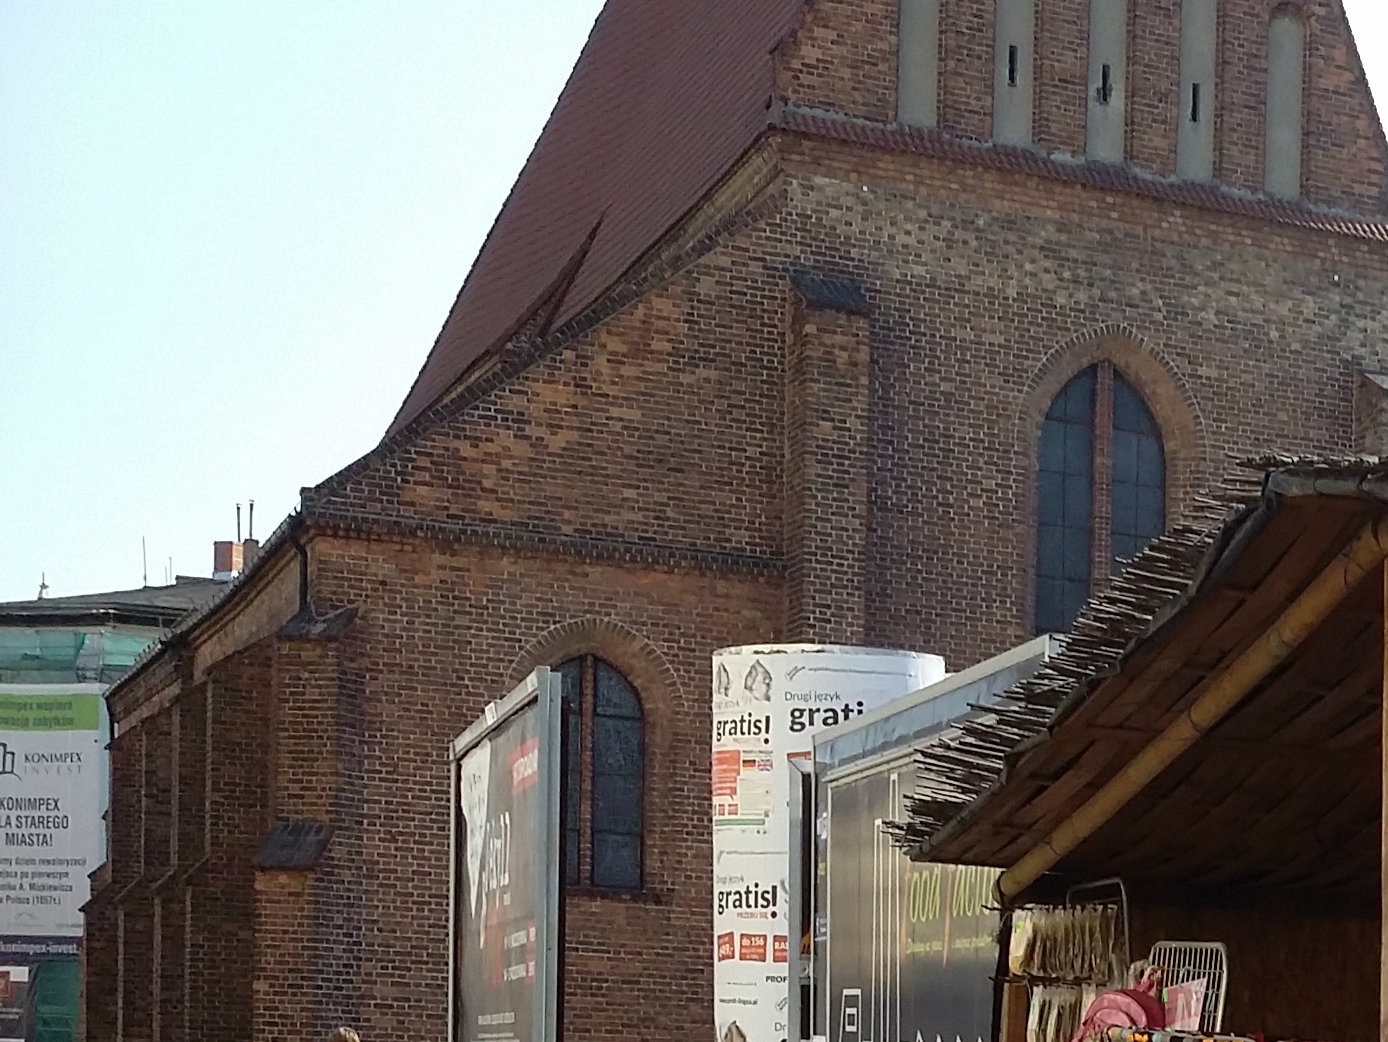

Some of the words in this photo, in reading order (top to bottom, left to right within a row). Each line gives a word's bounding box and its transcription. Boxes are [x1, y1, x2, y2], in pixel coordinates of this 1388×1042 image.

[785, 691, 812, 703] Drugi
[814, 690, 842, 703] język
[716, 711, 771, 745] gratis!
[24, 751, 83, 764] KONIMPEX
[24, 765, 82, 776] INVEST
[16, 814, 70, 829] STAREGO
[5, 832, 53, 847] MIASTA!
[717, 882, 778, 919] gratis!
